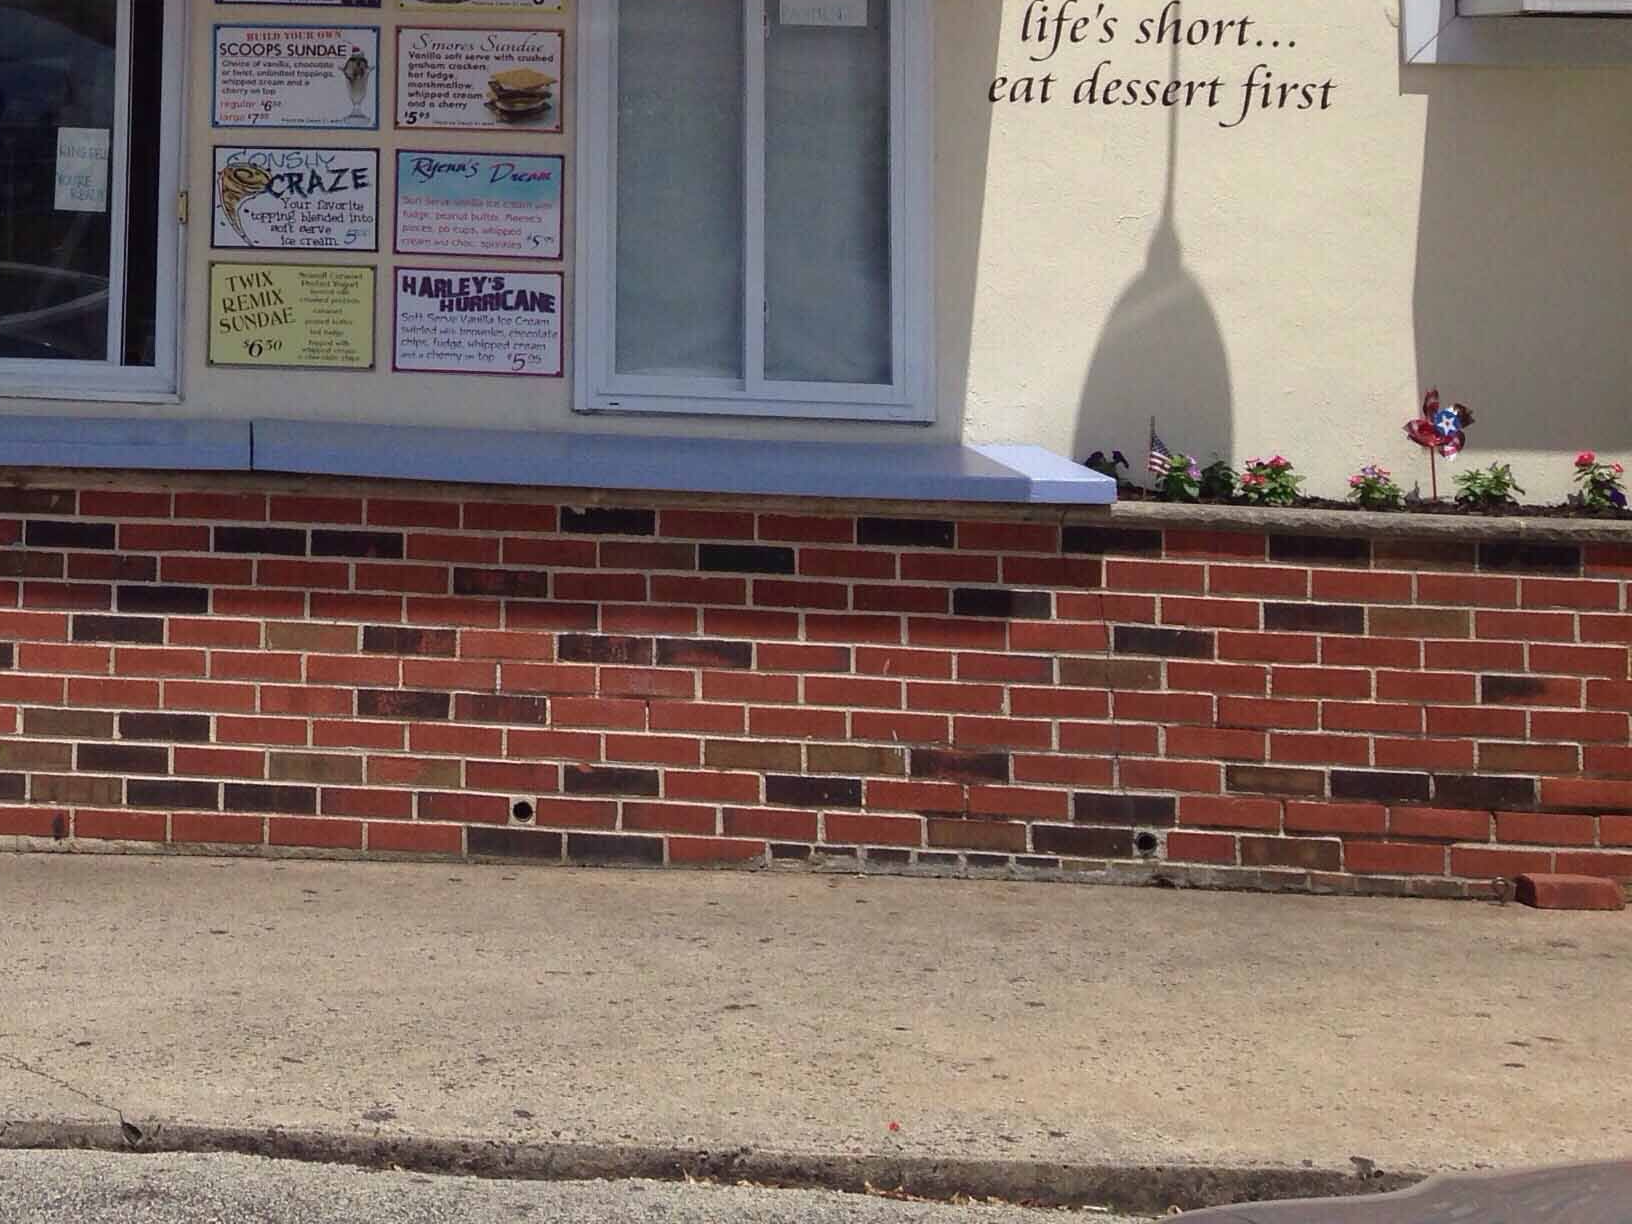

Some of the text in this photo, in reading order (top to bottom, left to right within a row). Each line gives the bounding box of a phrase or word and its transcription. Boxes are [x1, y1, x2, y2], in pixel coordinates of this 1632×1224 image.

[1133, 0, 1297, 49] short...
[219, 42, 347, 57] SCOOPS SUNDAE
[480, 32, 544, 54] Sundae
[987, 60, 1337, 129] eat dessert first
[269, 167, 371, 198] CRAZE
[489, 162, 553, 185] Dream
[281, 197, 313, 211] Your
[225, 270, 274, 293] TWIX
[400, 275, 506, 299] HARLEY'S
[221, 287, 286, 315] REMIX
[439, 288, 557, 314] HURRICANE
[218, 307, 297, 335] SUNDAE
